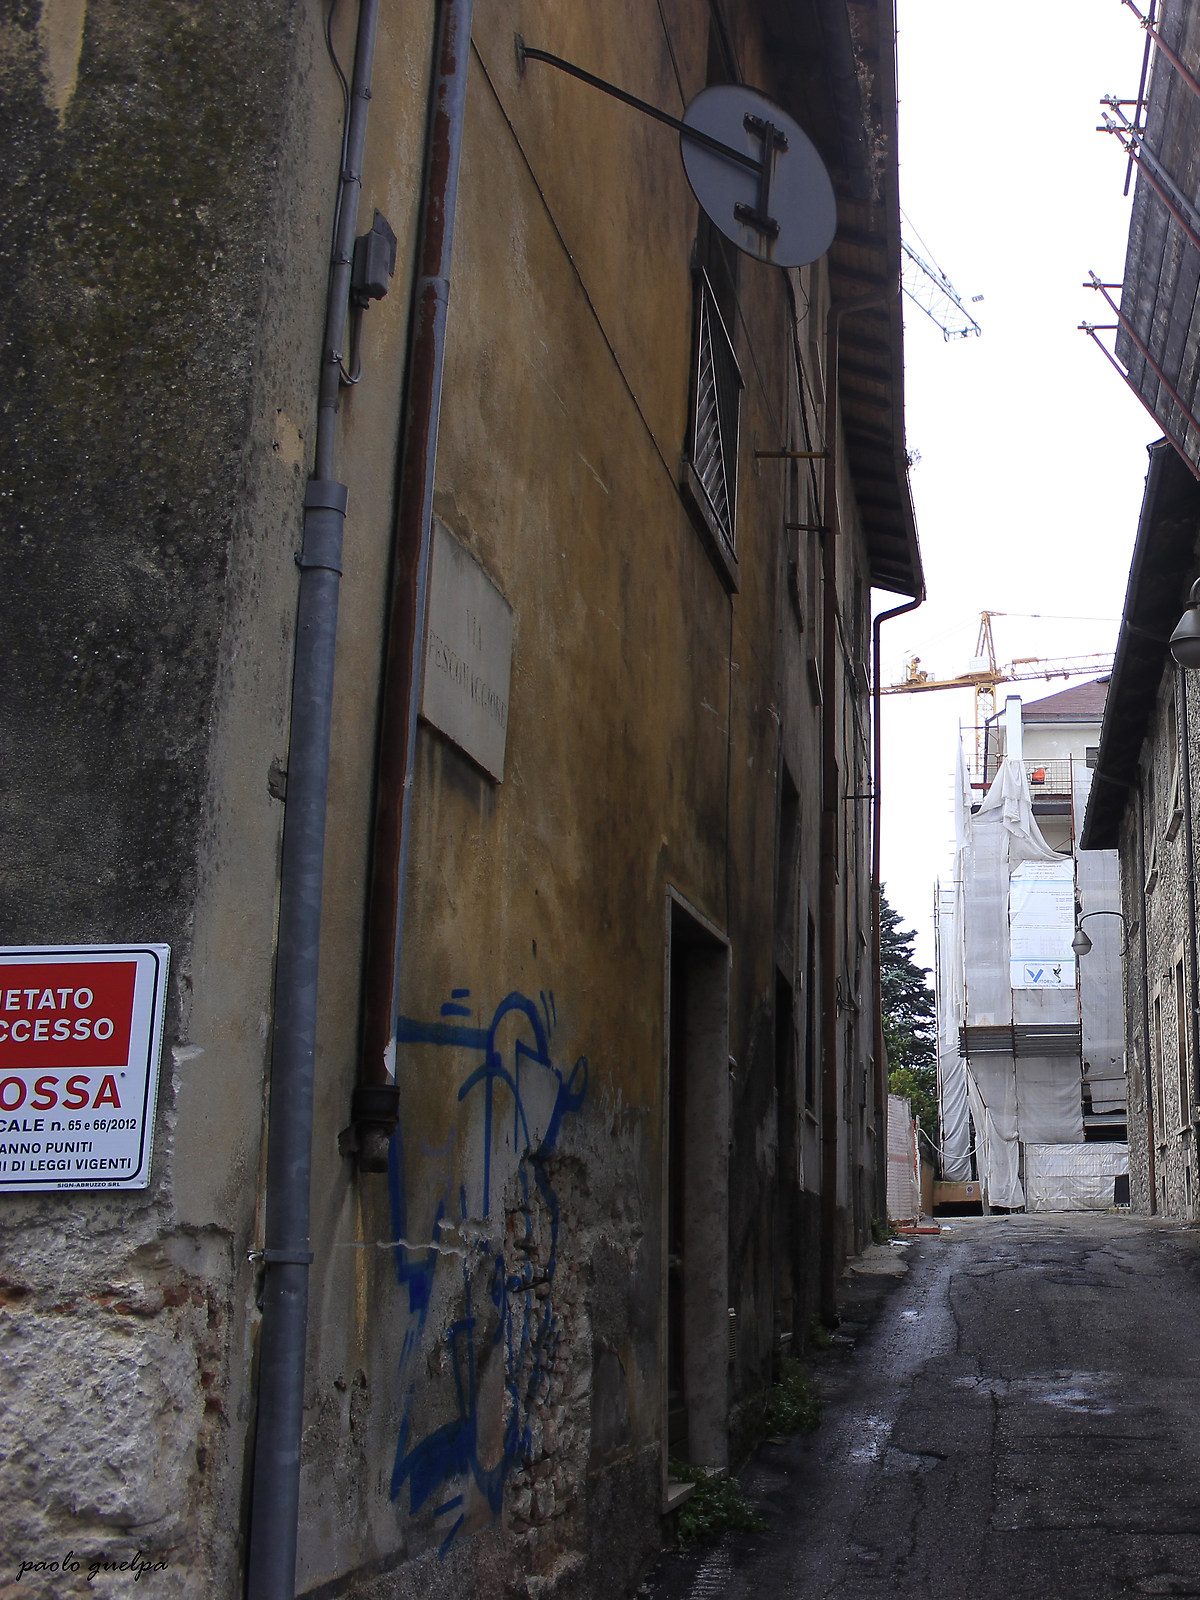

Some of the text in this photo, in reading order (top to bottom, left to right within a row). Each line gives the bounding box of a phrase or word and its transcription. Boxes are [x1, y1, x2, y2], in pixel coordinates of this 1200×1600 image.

[0, 988, 94, 1010] ETATO
[0, 1075, 122, 1111] OSSA
[51, 1120, 65, 1131] n.
[68, 1120, 82, 1131] 65
[84, 1121, 91, 1130] e
[93, 1118, 137, 1133] 66/2012
[45, 1141, 93, 1154] PUNITI
[11, 1160, 26, 1172] DI
[30, 1159, 71, 1171] LEGGI
[75, 1158, 131, 1170] VIGENTI
